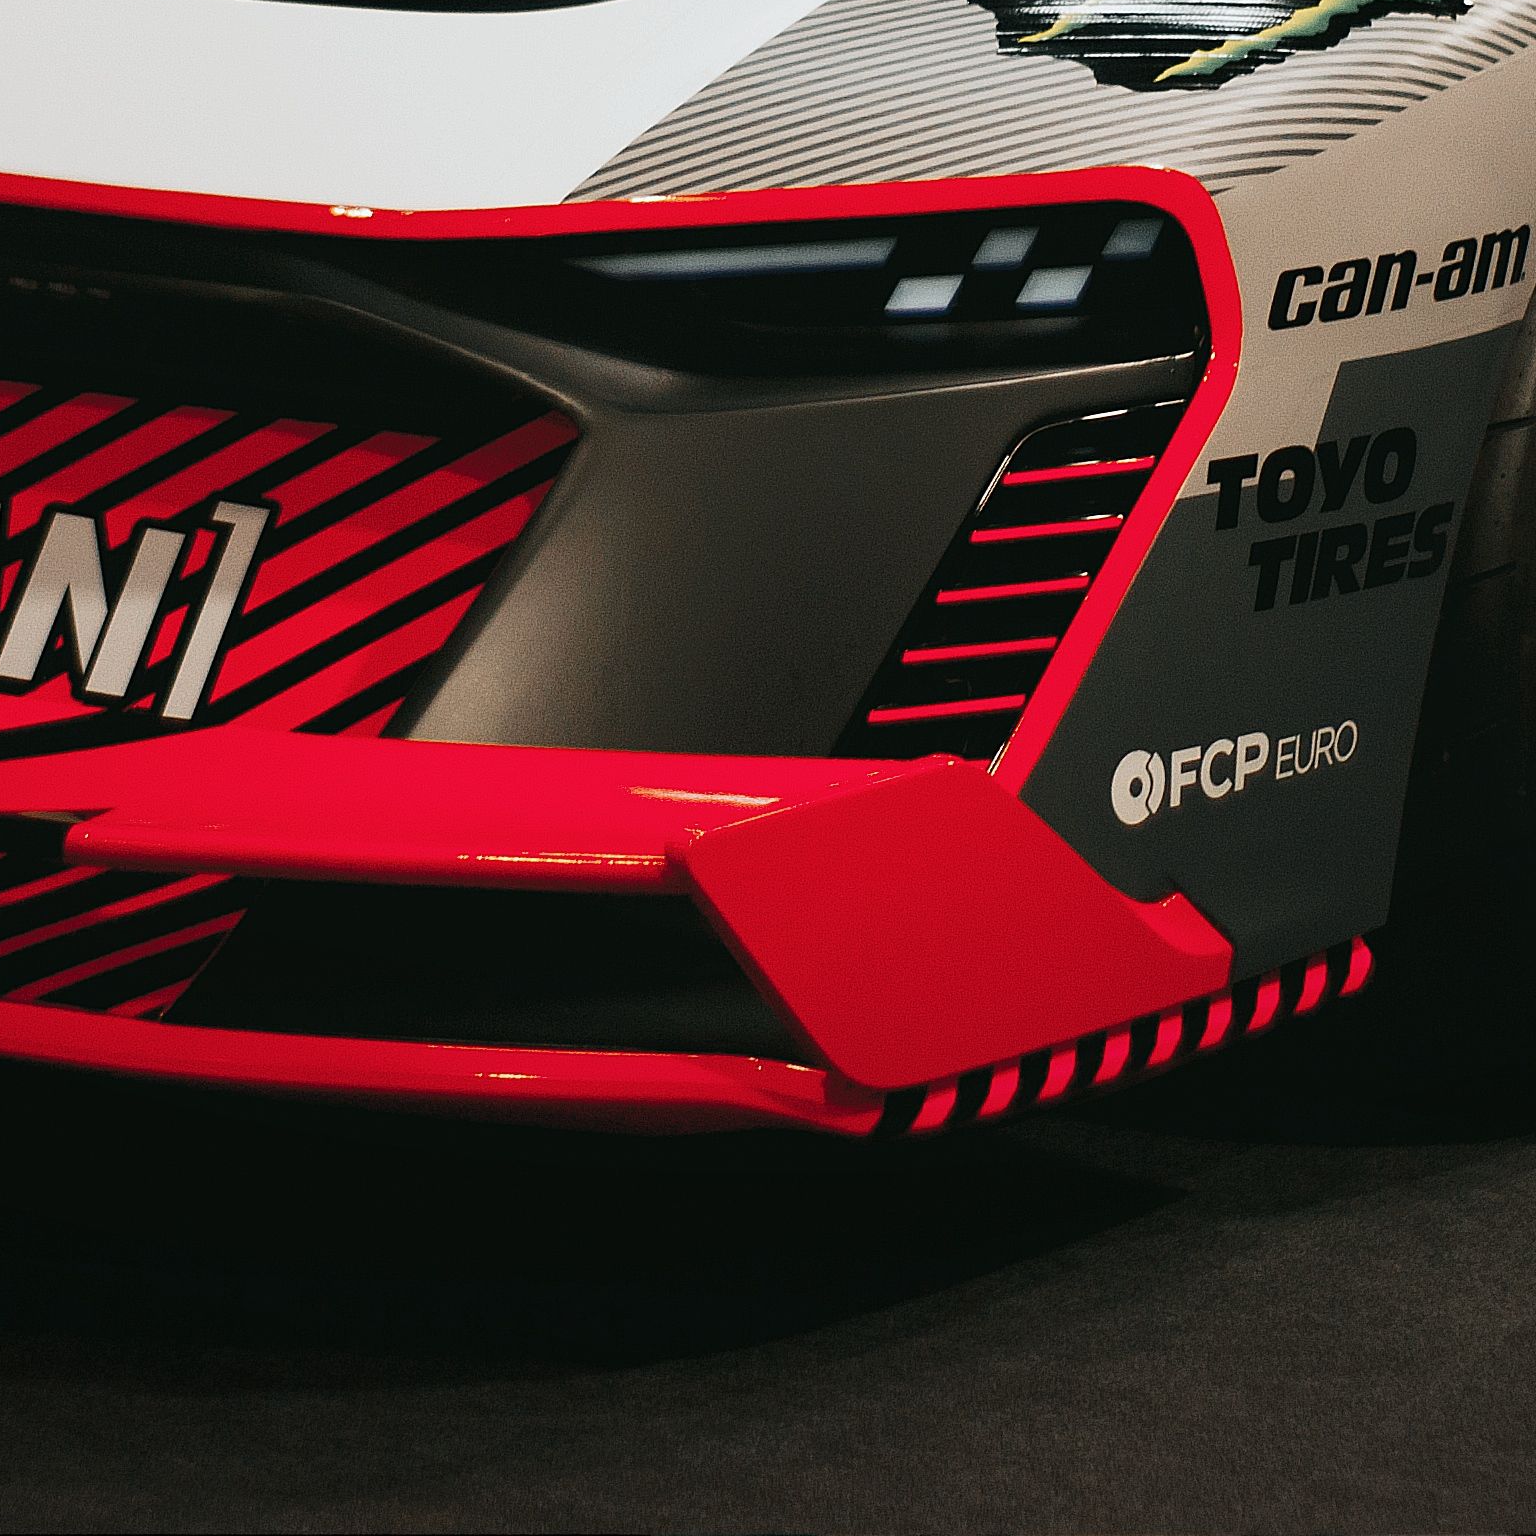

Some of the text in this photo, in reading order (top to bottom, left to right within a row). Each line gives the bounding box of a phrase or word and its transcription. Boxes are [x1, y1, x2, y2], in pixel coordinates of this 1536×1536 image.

[1267, 223, 1532, 331] can-am
[1207, 425, 1418, 531] TOYO
[1248, 501, 1457, 613] TIRES
[1169, 719, 1359, 808] FCP EURO
